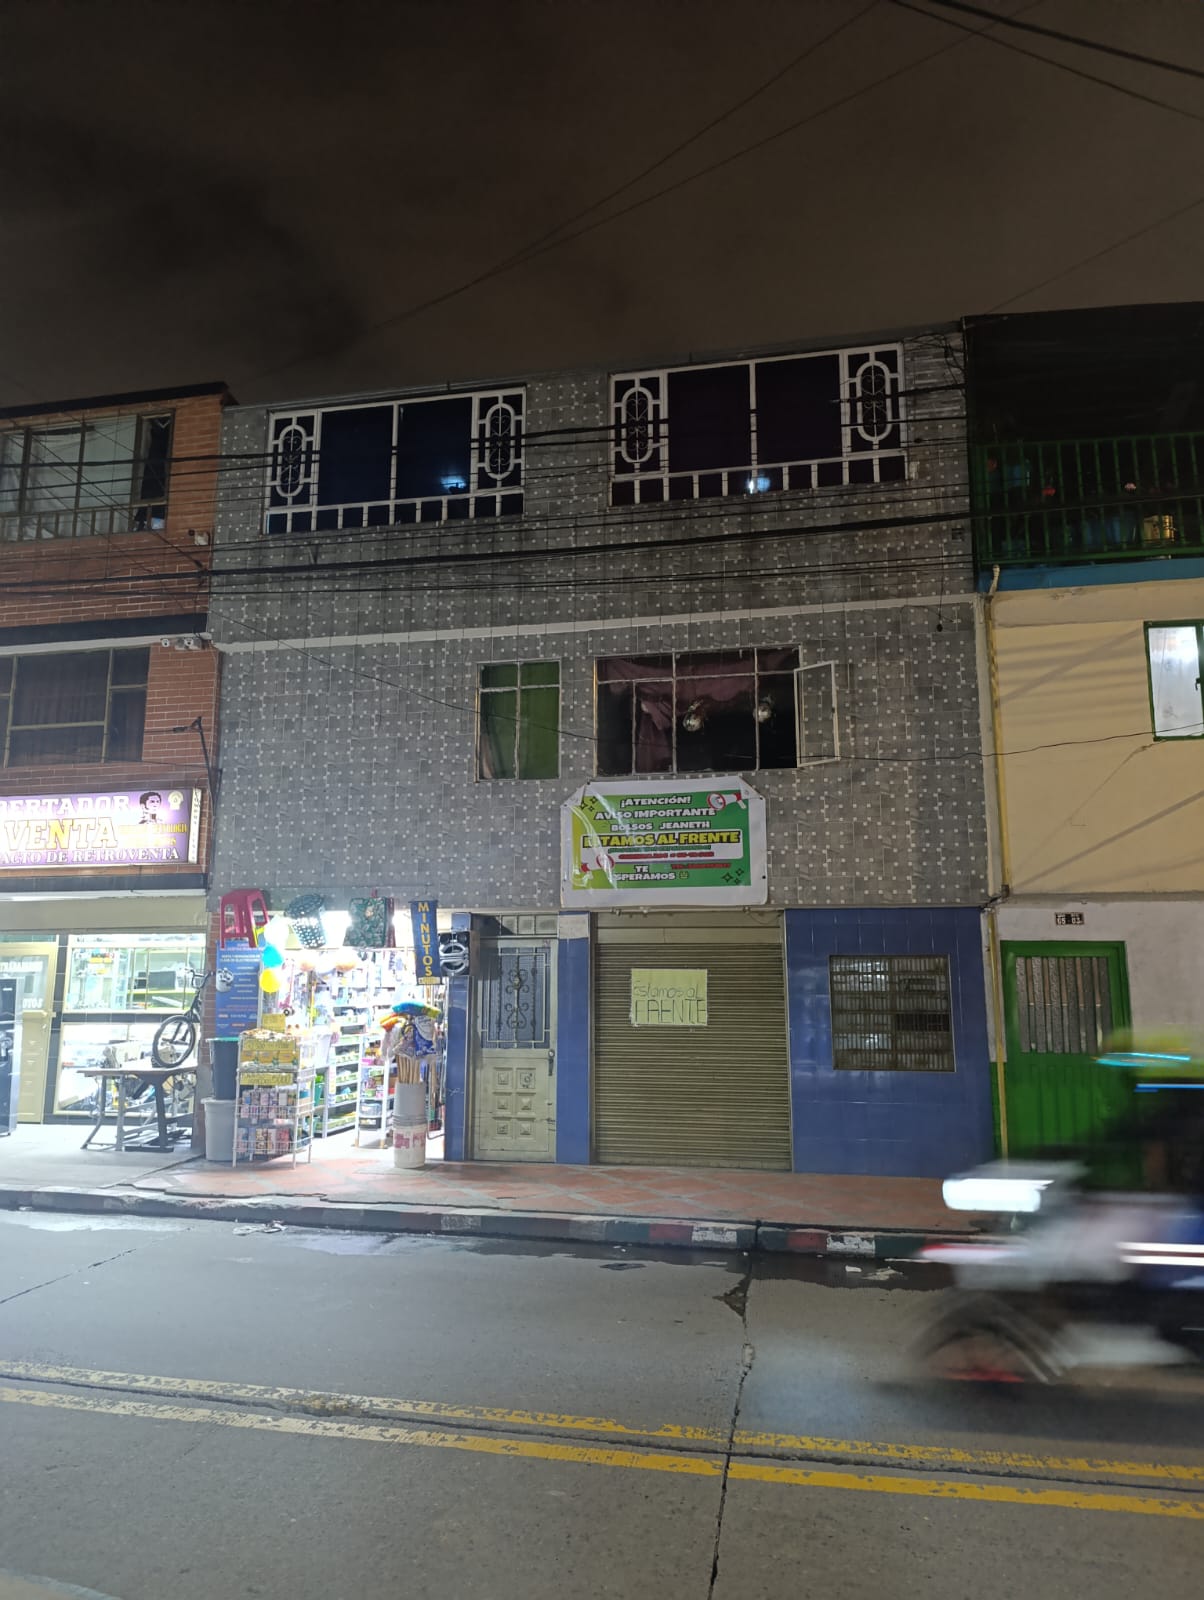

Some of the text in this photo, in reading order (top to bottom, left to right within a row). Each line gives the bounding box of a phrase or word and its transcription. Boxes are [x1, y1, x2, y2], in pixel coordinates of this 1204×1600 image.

[634, 808, 716, 818] IMPORTANTE
[611, 821, 710, 831] BOLSOS JEANETH
[4, 816, 118, 850] VENTA
[583, 831, 740, 848] ETAMOS AL FRENTE
[47, 850, 68, 862] DE
[72, 847, 179, 862] RETROVENTA
[634, 865, 649, 873] TE
[609, 872, 675, 881] SPERAMOS
[417, 901, 433, 977] MINUTOS
